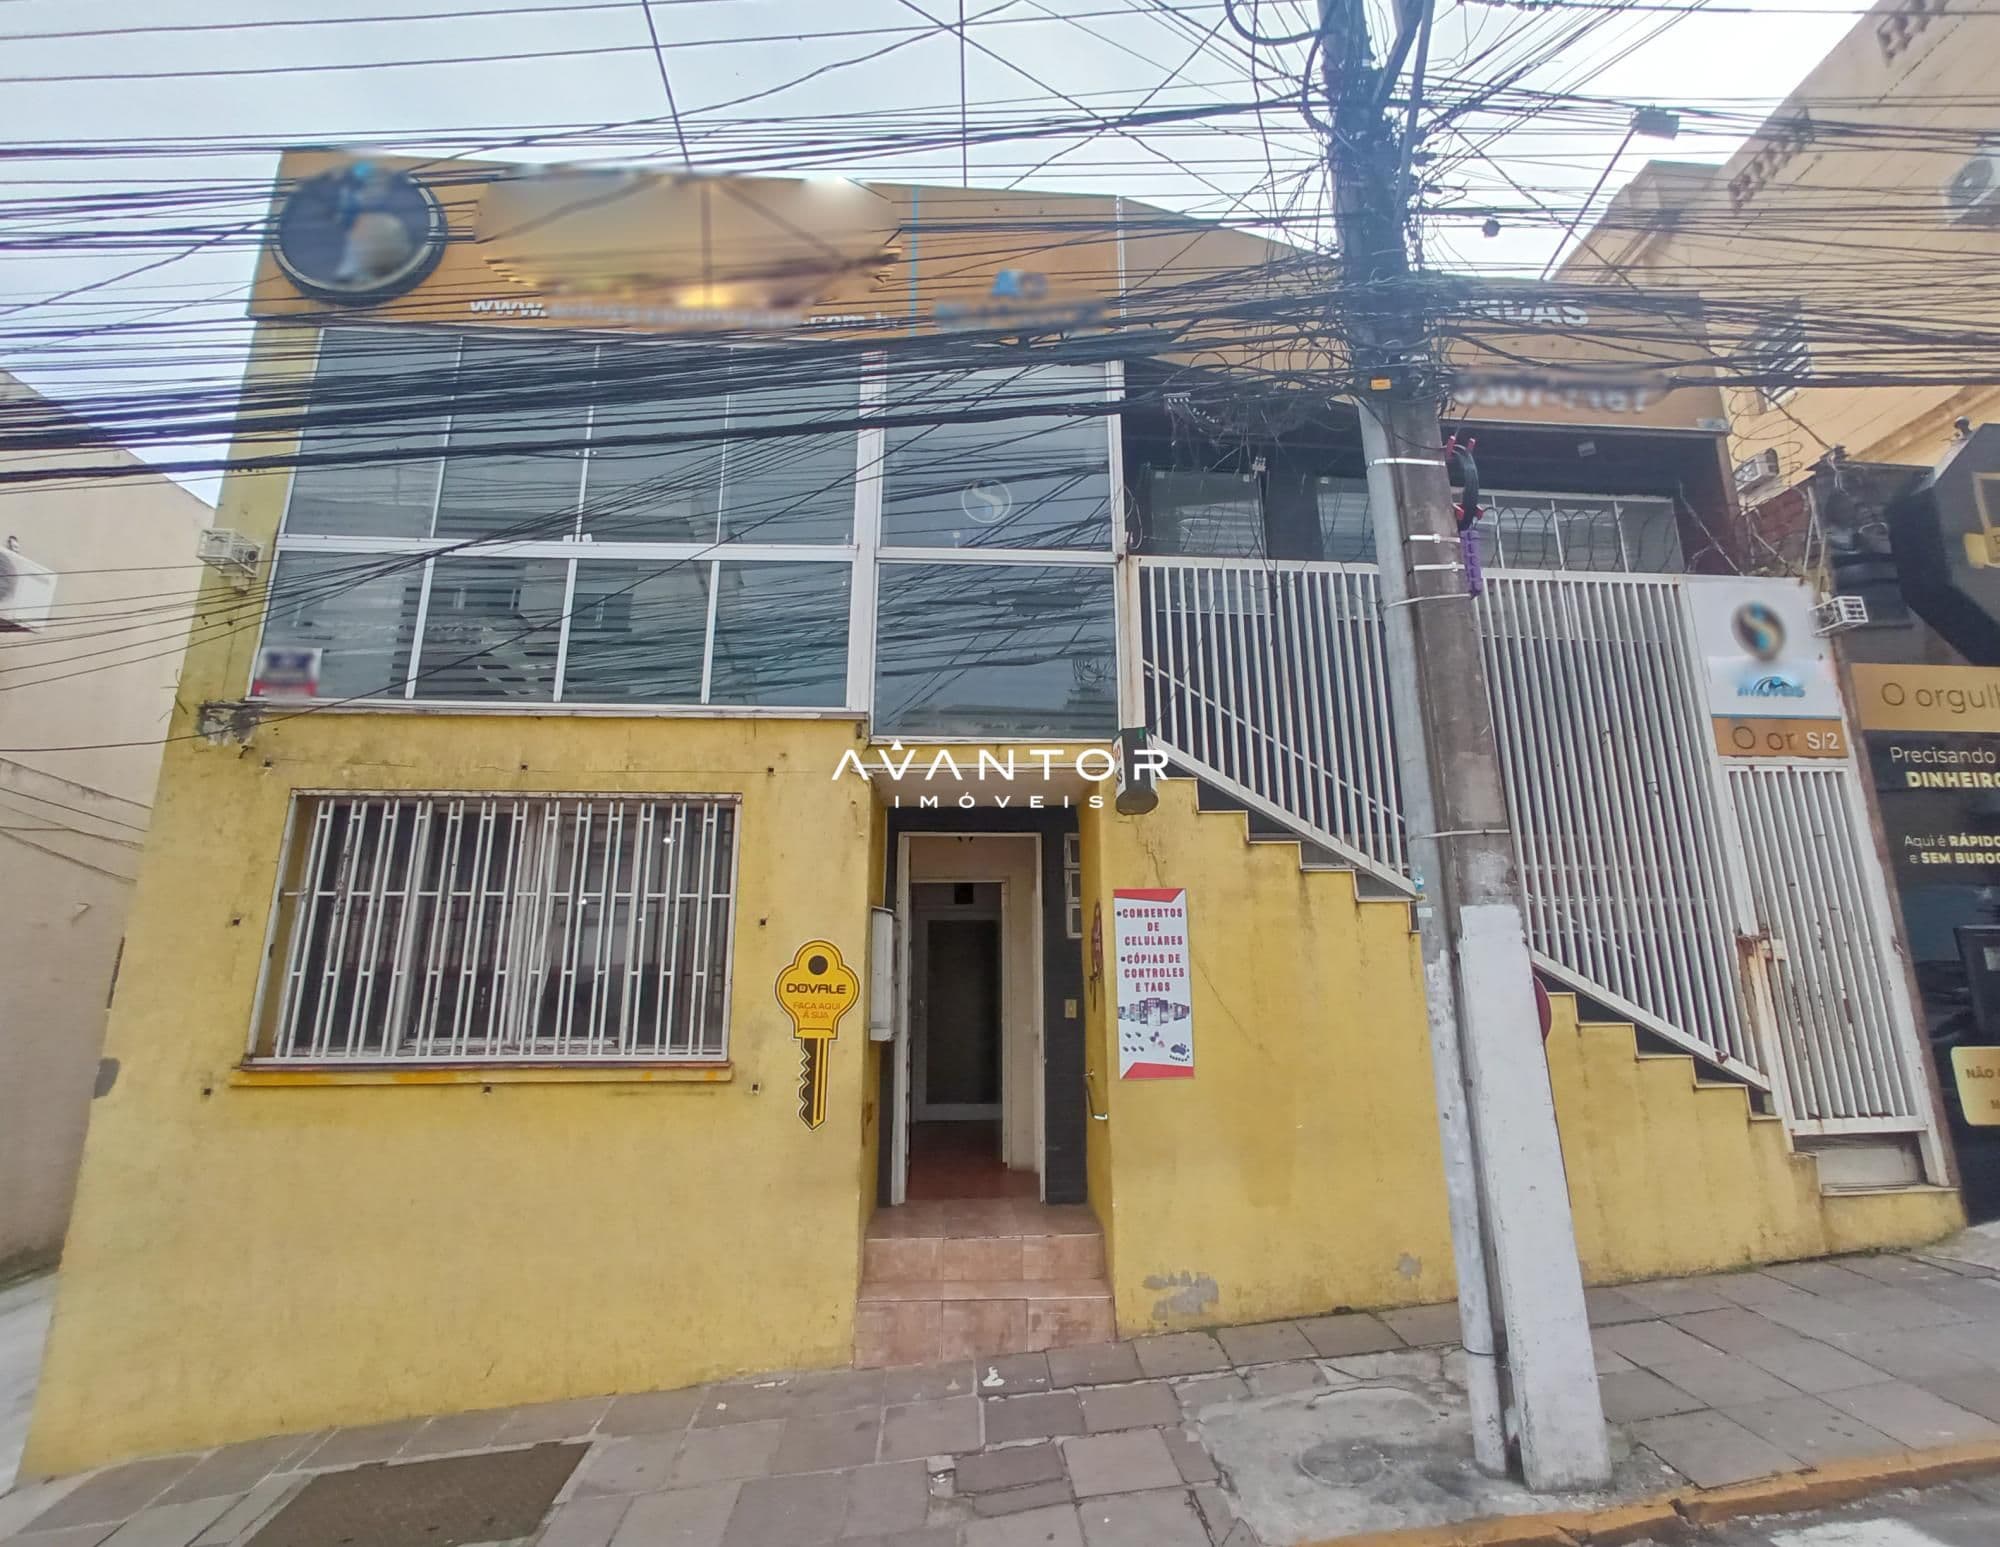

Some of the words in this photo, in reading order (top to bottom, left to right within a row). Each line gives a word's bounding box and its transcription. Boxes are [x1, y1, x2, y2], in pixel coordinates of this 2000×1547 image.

[1880, 682, 1905, 706] O
[1889, 746, 1996, 765] Precisando
[1904, 834, 1935, 849] Aqui
[1909, 854, 1919, 864] e
[1920, 852, 1952, 864] SEM
[1122, 908, 1183, 918] CONSERTOS
[1147, 922, 1160, 932] DE
[1124, 936, 1183, 946] CELULARES
[1127, 952, 1165, 964] CÓPIAS
[1168, 953, 1181, 963] DE
[1124, 967, 1185, 978] CONTROLES
[786, 983, 847, 994] DOVALE
[1136, 982, 1141, 992] E
[1144, 982, 1171, 992] TAGS
[1965, 1066, 1993, 1079] NÃO
